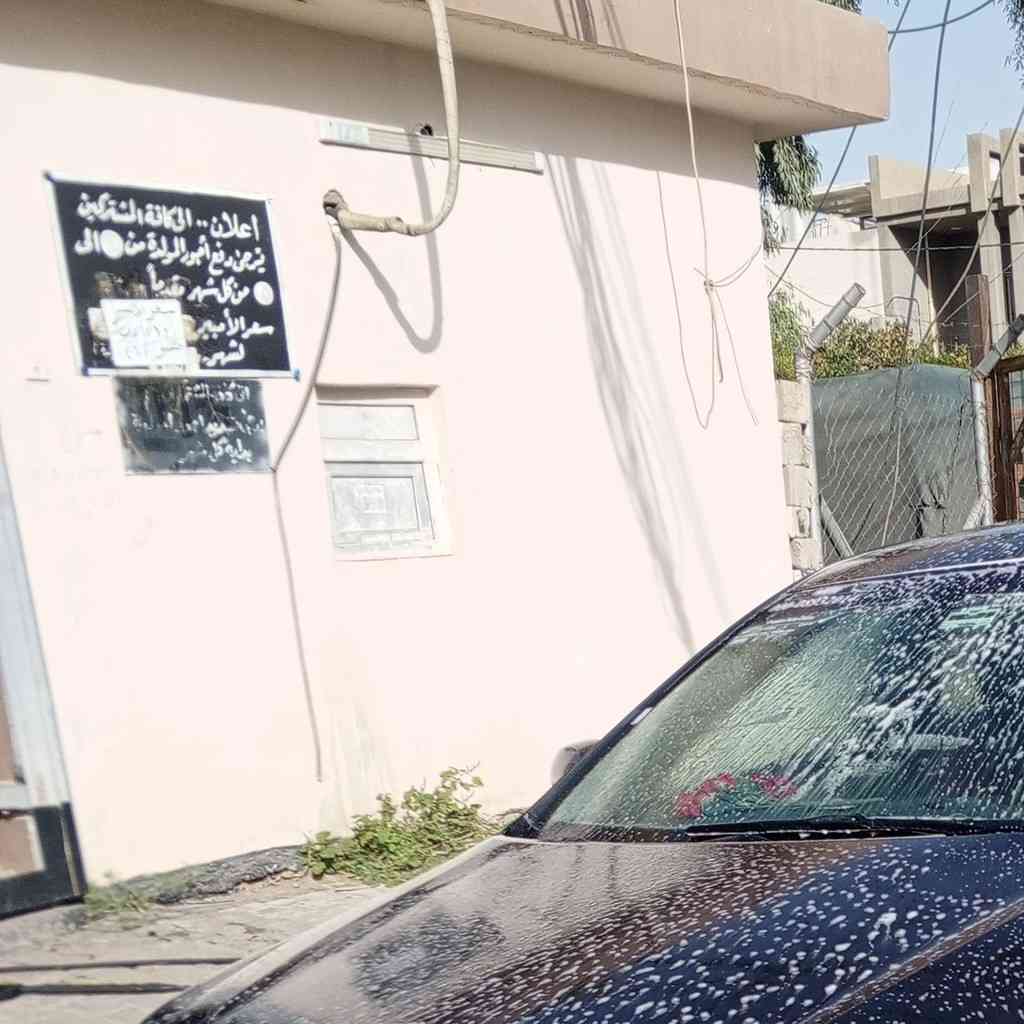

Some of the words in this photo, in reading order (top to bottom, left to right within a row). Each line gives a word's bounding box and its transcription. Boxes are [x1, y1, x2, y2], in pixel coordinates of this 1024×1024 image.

[77, 191, 145, 227] المشتركين
[74, 227, 101, 257] الى
[124, 230, 146, 257] من
[186, 277, 219, 304] شهر
[230, 282, 251, 307] من
[241, 320, 275, 340] سعر
